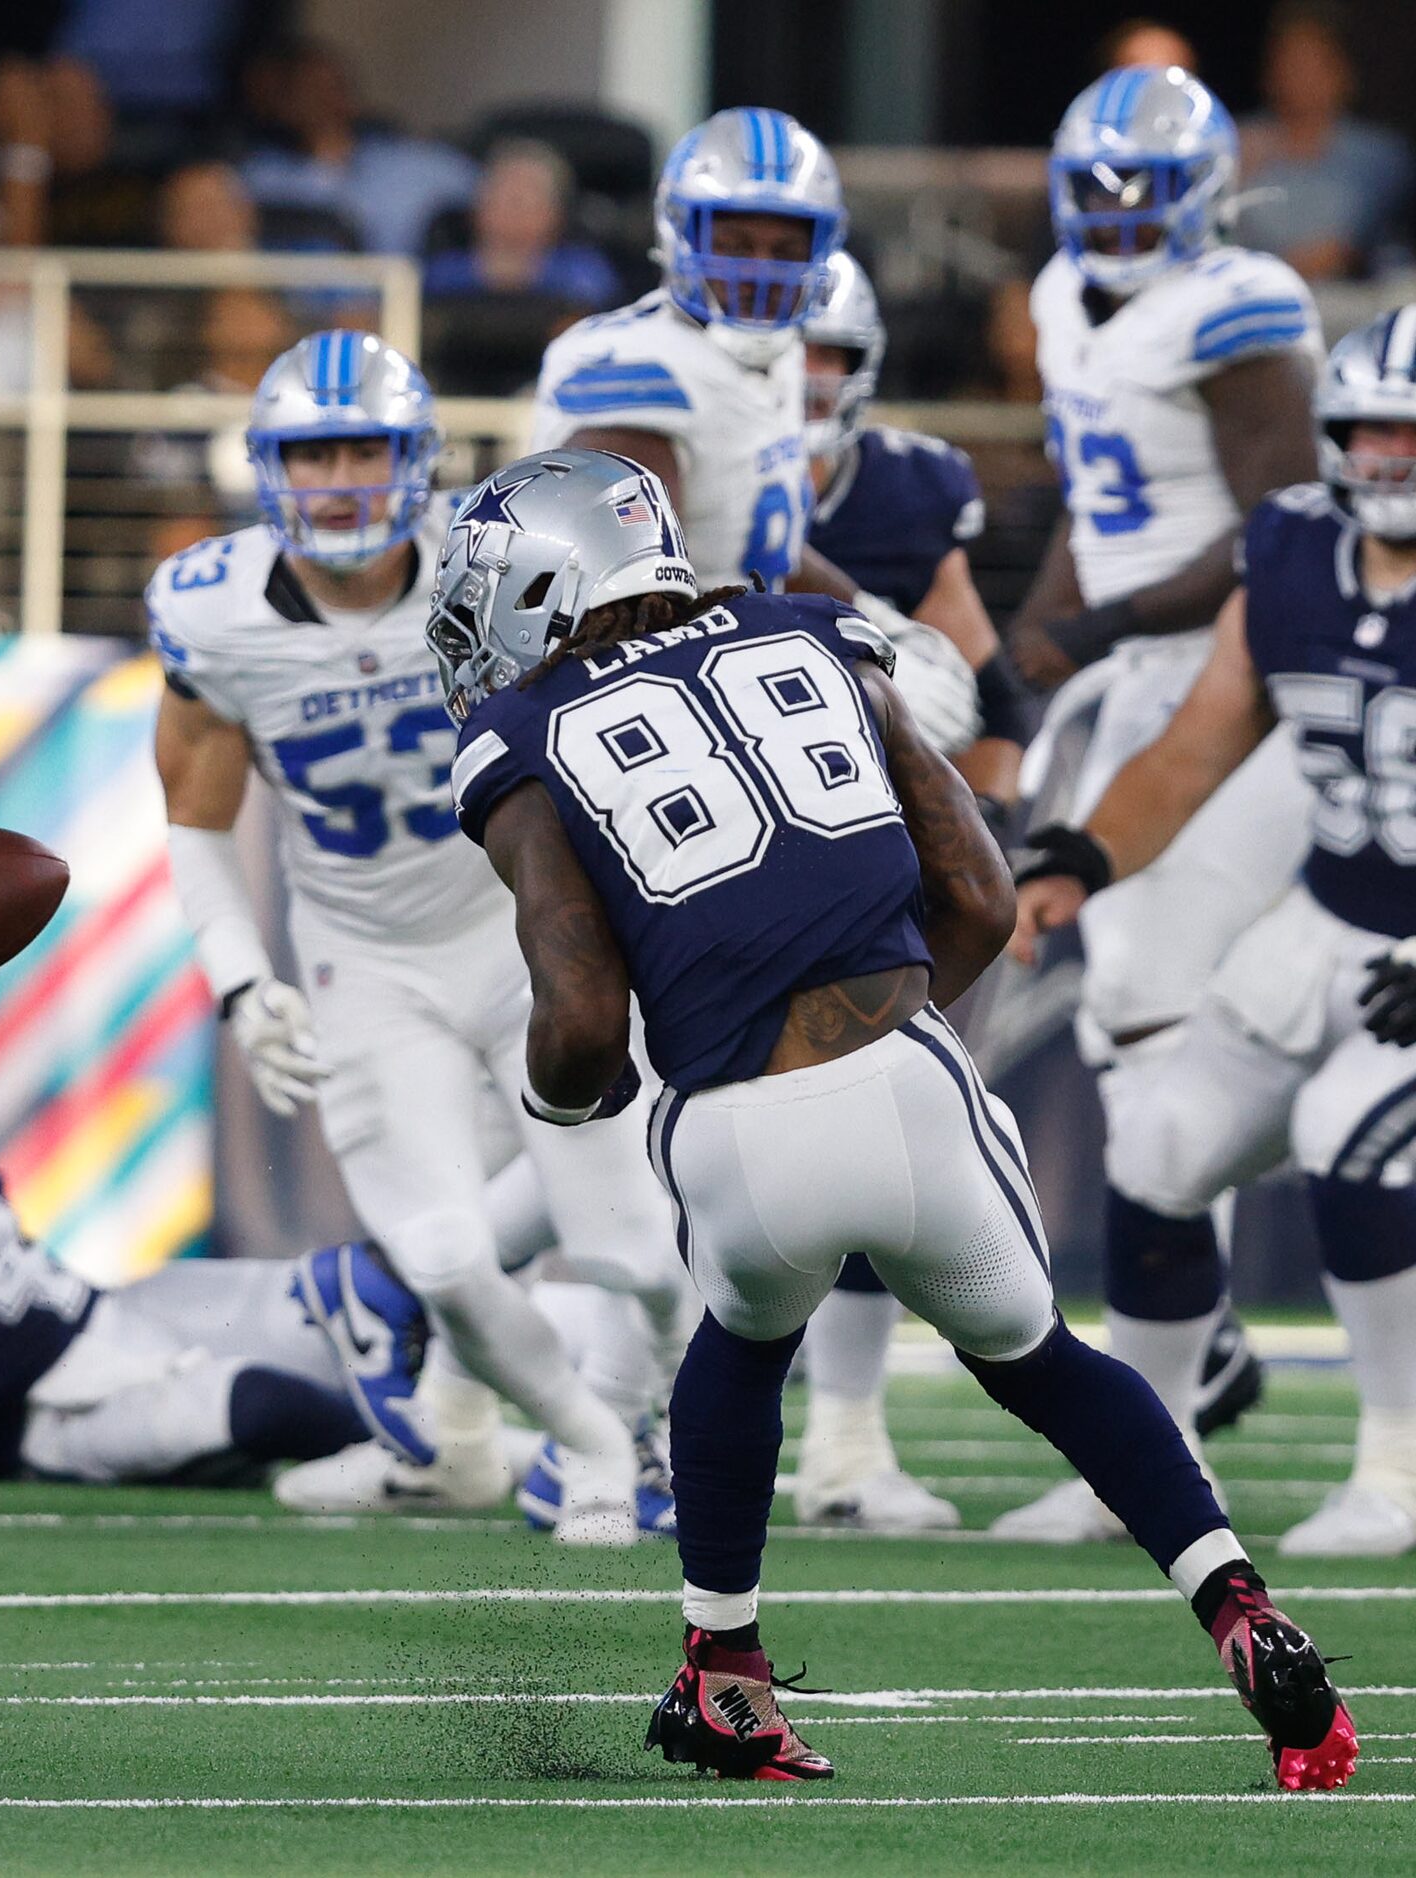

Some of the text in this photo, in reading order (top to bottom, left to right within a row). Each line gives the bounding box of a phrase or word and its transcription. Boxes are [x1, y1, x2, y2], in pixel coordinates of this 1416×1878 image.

[583, 604, 740, 681] LAMB
[271, 700, 464, 860] 53
[546, 629, 906, 907] 88
[711, 1682, 763, 1743] NIKE
